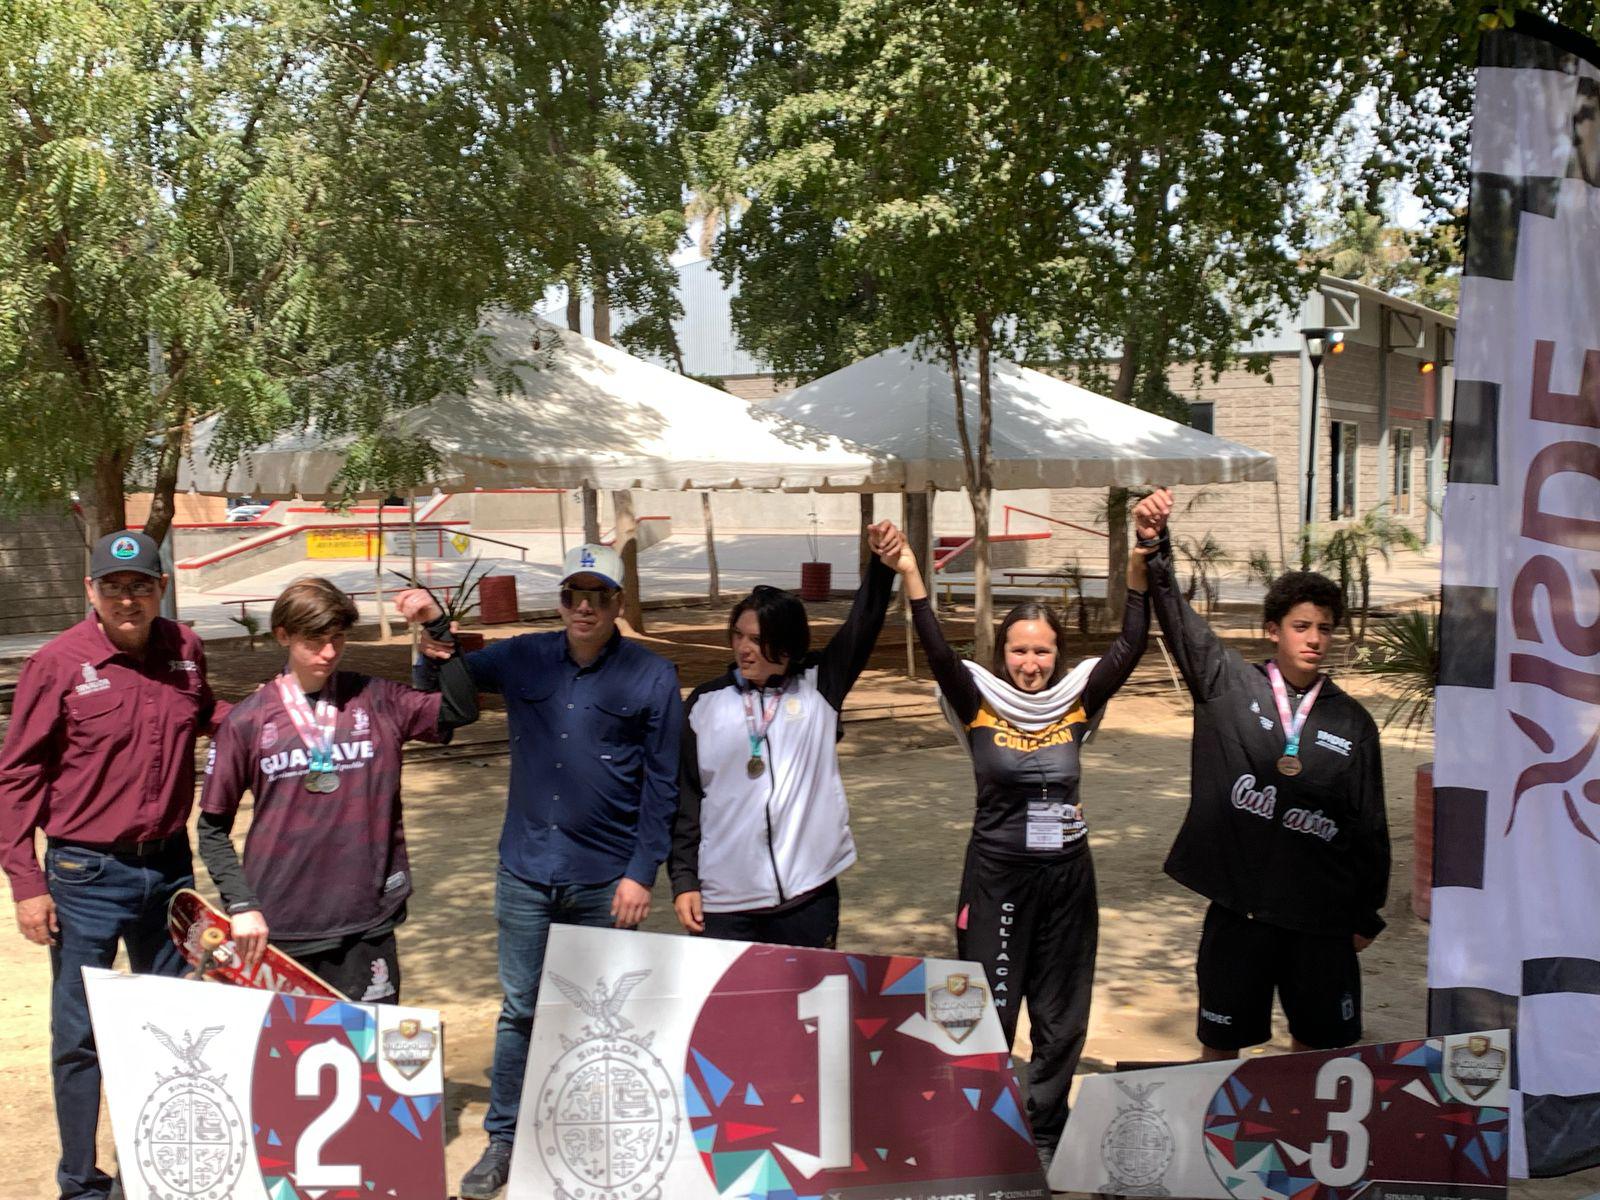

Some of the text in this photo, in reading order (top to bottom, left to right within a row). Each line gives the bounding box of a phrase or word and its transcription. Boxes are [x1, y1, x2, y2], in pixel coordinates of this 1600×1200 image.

[260, 740, 375, 775] GUAAVE
[167, 1081, 216, 1094] SINALOA
[576, 1043, 640, 1061] SINALOA
[798, 974, 851, 1168] 1
[295, 1040, 362, 1188] 2
[1309, 1056, 1375, 1188] 3
